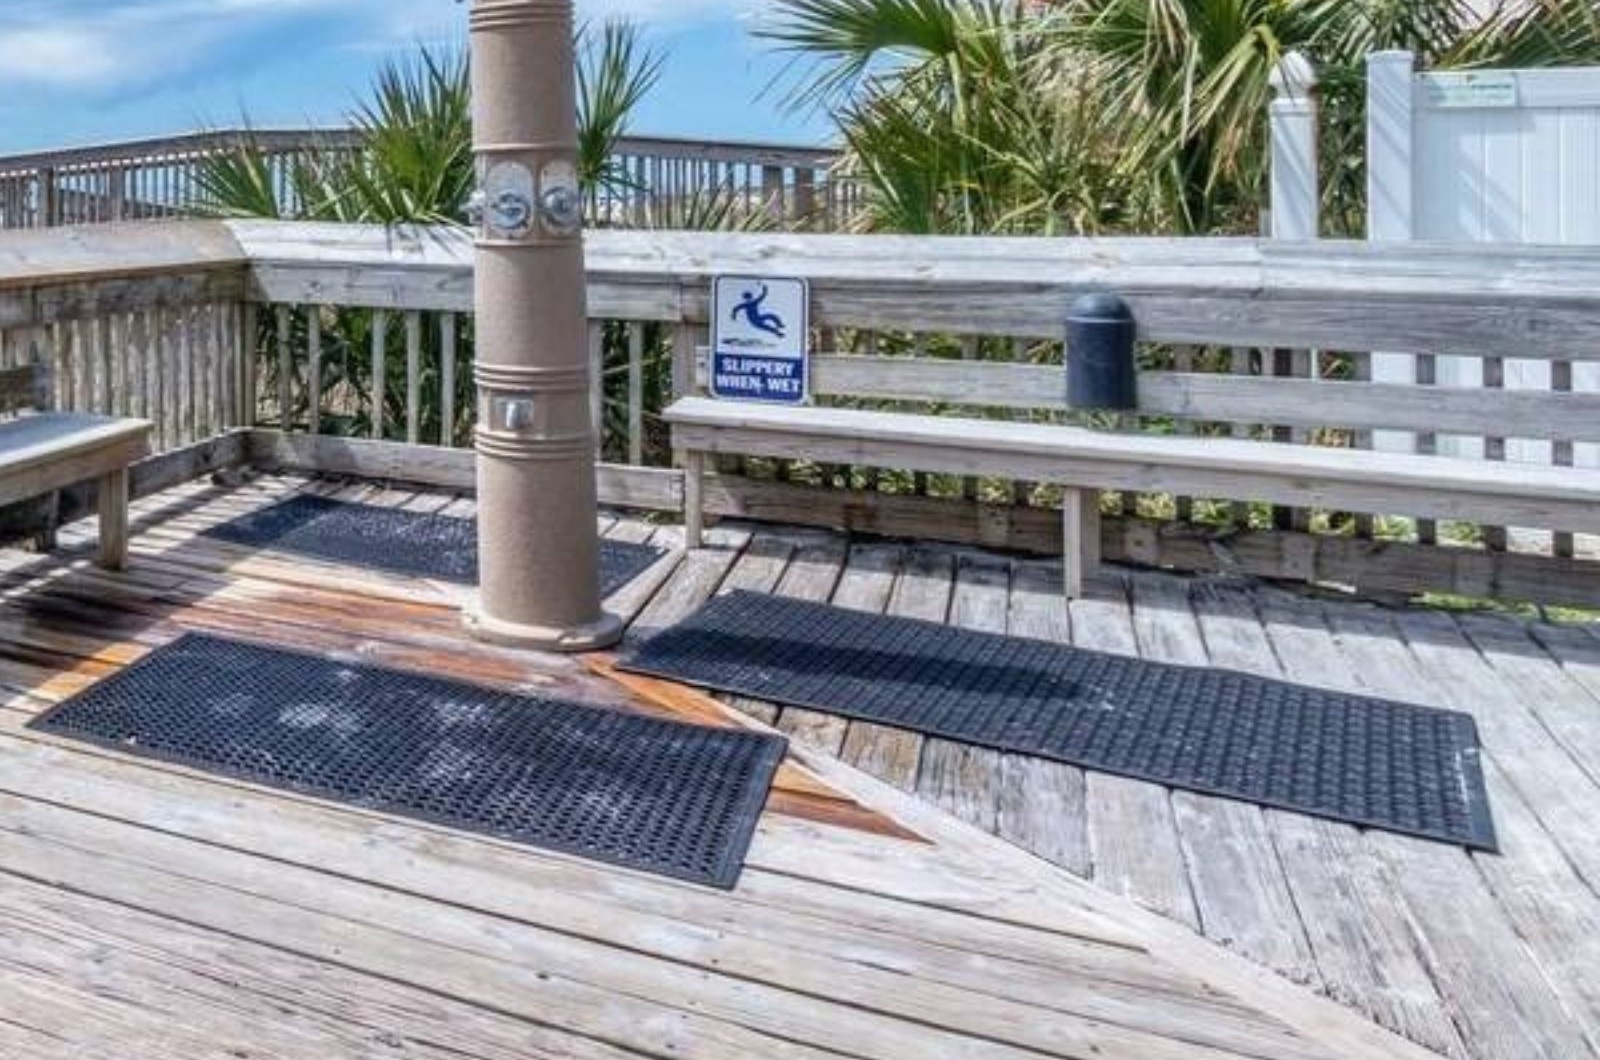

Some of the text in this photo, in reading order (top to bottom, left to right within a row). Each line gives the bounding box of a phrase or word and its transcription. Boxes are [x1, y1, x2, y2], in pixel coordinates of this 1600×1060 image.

[721, 357, 795, 376] SLIPPERY
[716, 374, 801, 393] WHEN WET
